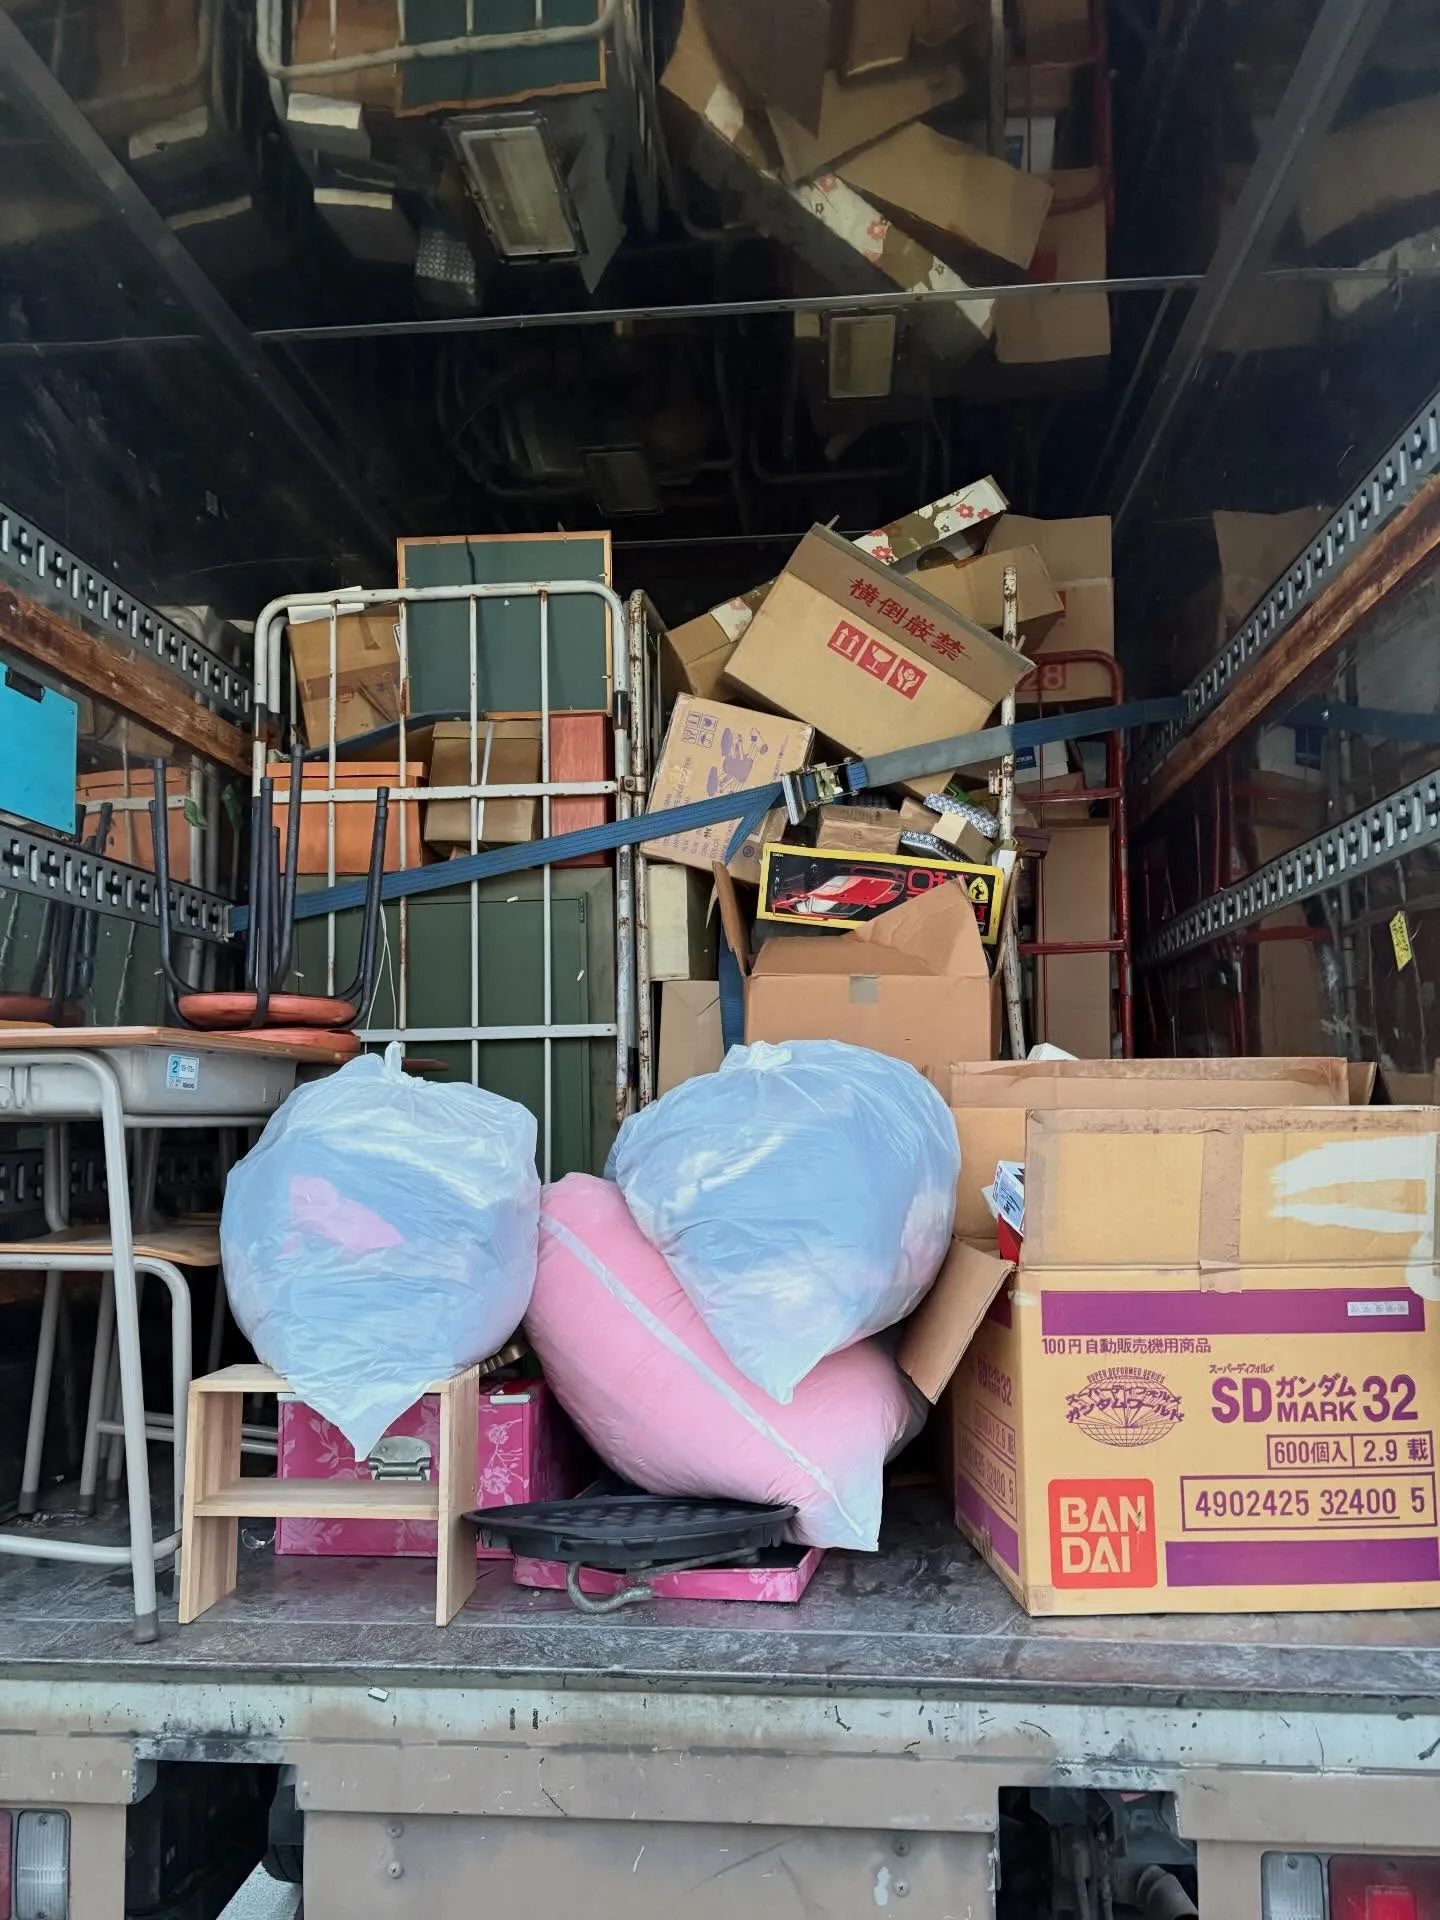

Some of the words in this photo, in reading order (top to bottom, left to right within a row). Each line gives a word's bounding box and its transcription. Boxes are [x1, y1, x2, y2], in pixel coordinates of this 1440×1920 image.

[848, 577, 966, 662] 横倒厳禁
[172, 1060, 179, 1074] 2
[1042, 1337, 1082, 1355] 100円
[1086, 1337, 1212, 1355] 自動販売機用商品
[1086, 1369, 1108, 1384] SUPER
[1107, 1366, 1142, 1378] DEFORMED
[1143, 1368, 1166, 1384] SERIES
[1208, 1363, 1275, 1374] スーパーディフォルメ
[1211, 1376, 1272, 1424] SD
[1275, 1373, 1357, 1399] ガンダム
[1362, 1374, 1418, 1422] 32
[1276, 1401, 1358, 1422] MARK
[1274, 1440, 1348, 1464] 600個入
[1363, 1439, 1398, 1463] 2.9
[1407, 1438, 1428, 1461] 載
[1060, 1495, 1147, 1533] BAN
[1195, 1489, 1310, 1517] 4902425
[1319, 1487, 1397, 1516] 32400
[1410, 1486, 1425, 1513] 5
[1061, 1536, 1131, 1574] DAI
